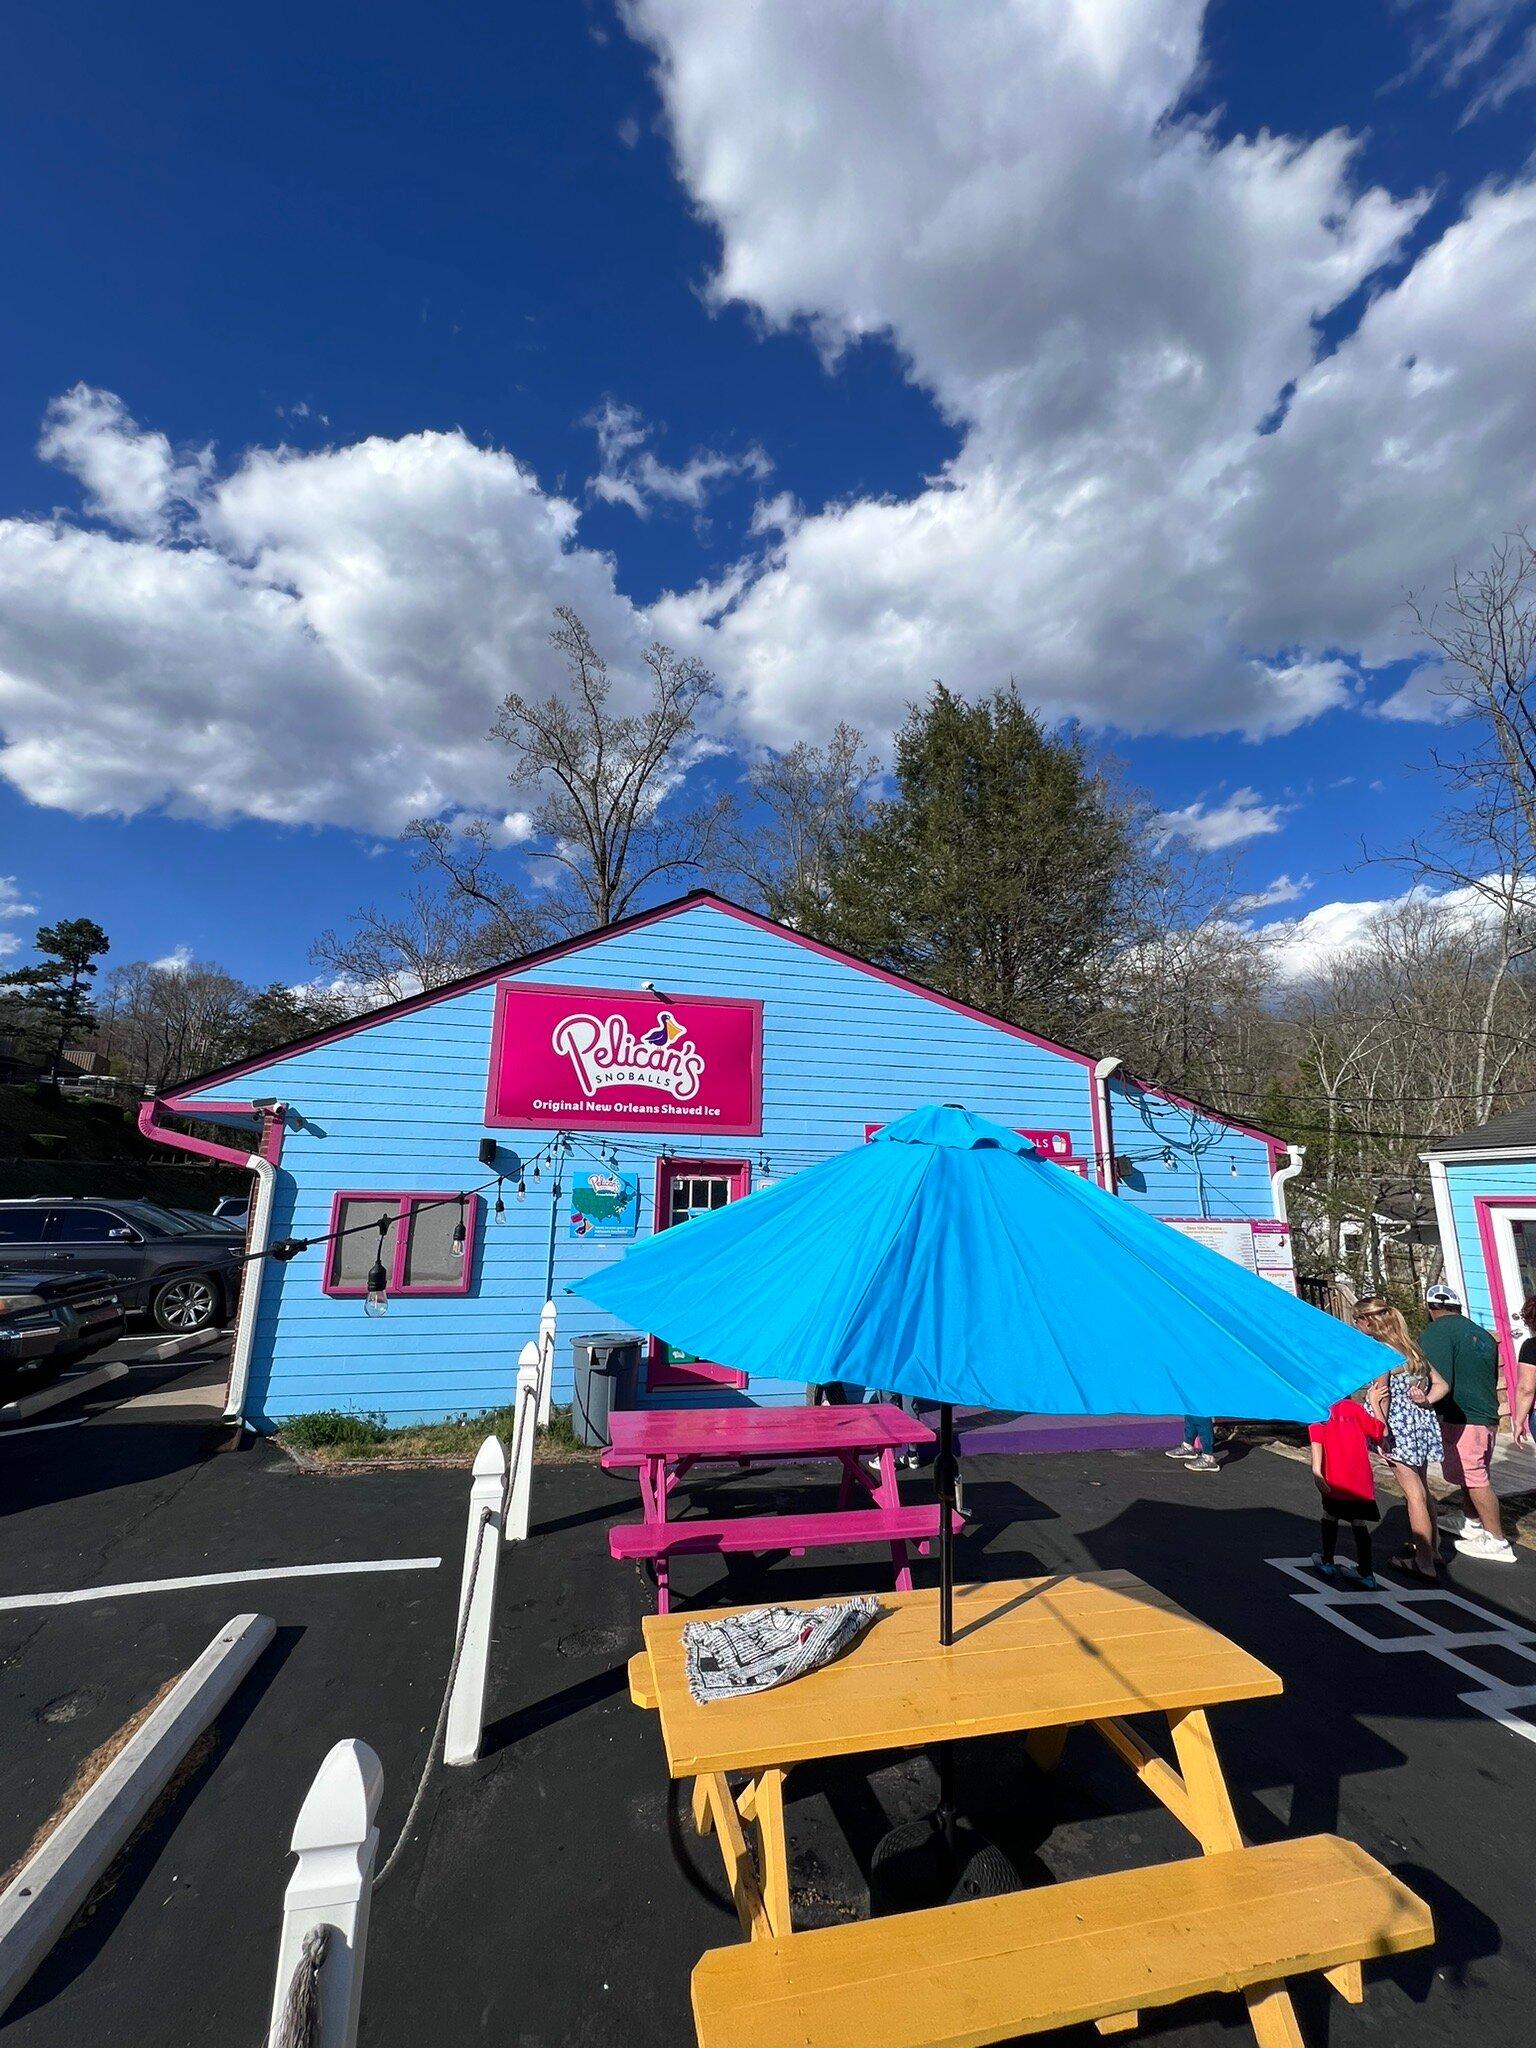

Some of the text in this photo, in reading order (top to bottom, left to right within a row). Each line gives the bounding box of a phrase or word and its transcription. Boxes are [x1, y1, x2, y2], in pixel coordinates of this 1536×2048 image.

[555, 1016, 702, 1097] Pelican's
[595, 1072, 671, 1087] SNOBALLS
[532, 1099, 721, 1116] Original New Orleans Shaved Ice
